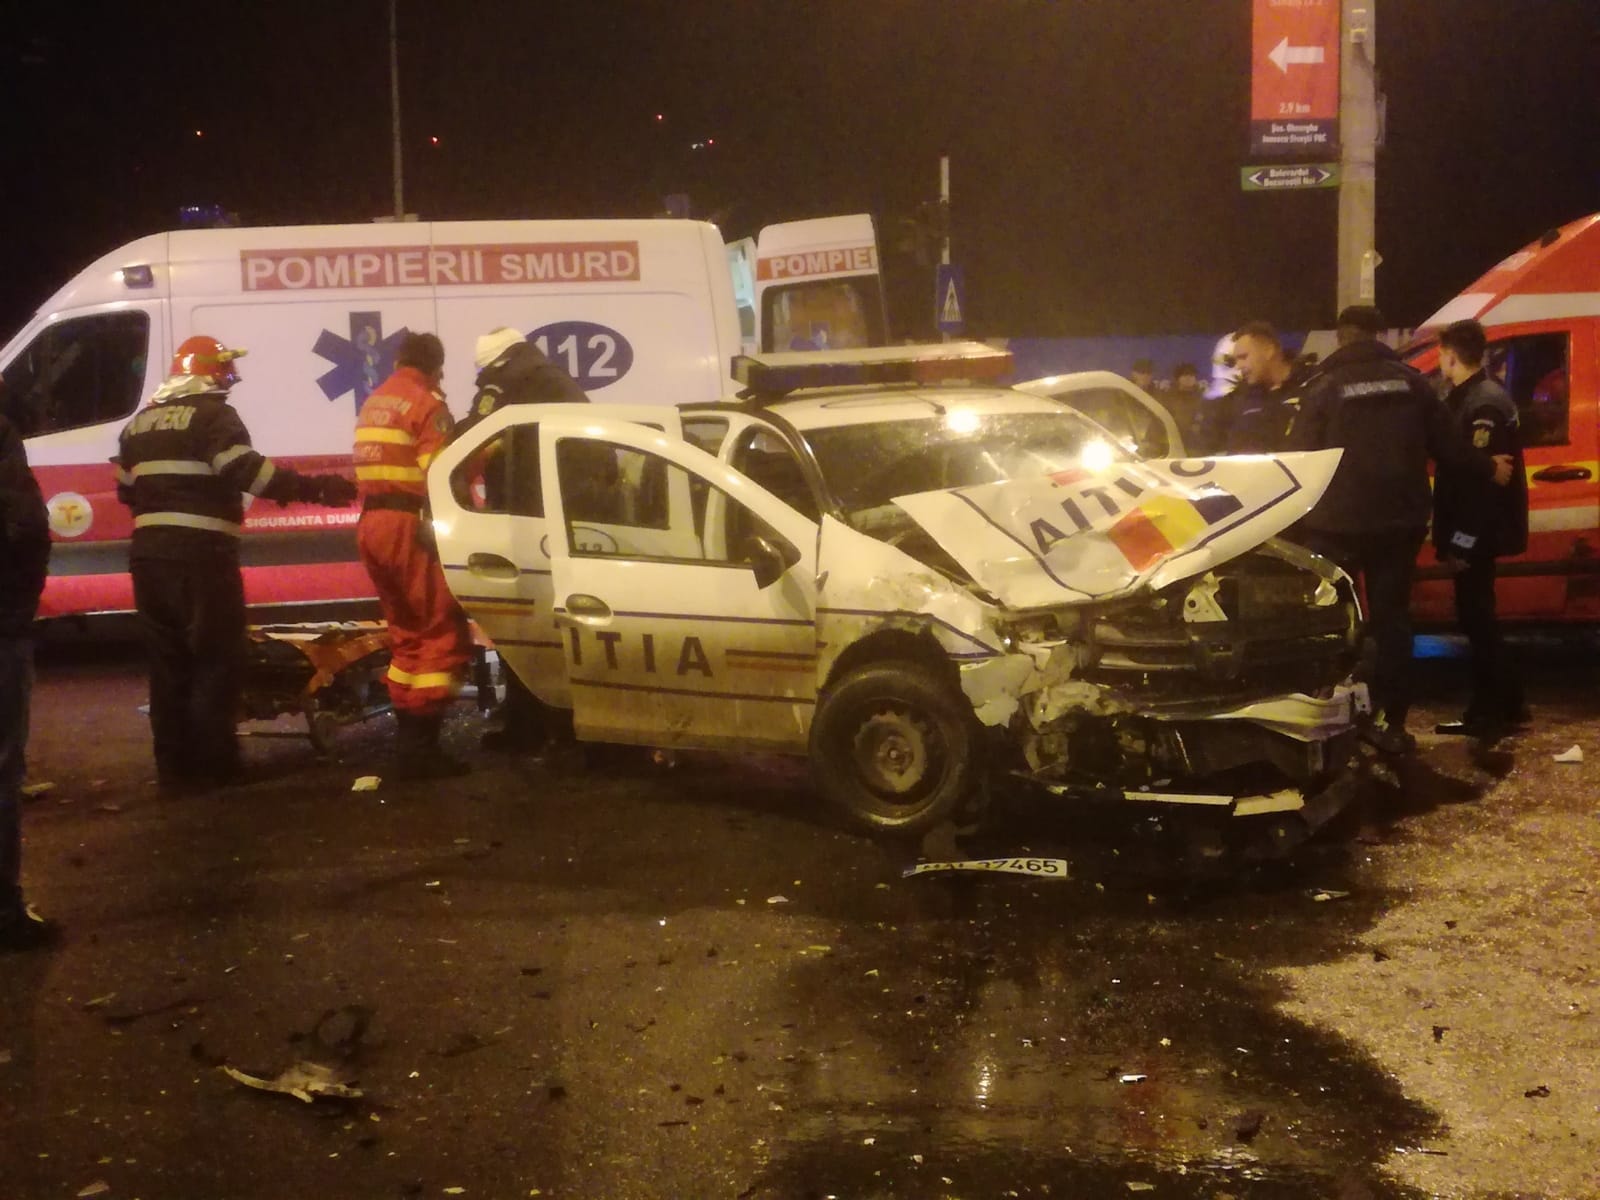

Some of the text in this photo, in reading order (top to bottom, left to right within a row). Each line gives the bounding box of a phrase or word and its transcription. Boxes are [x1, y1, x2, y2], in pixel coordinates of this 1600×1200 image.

[246, 249, 636, 291] POMPIERII SMURD
[244, 514, 324, 528] SIGURANTA
